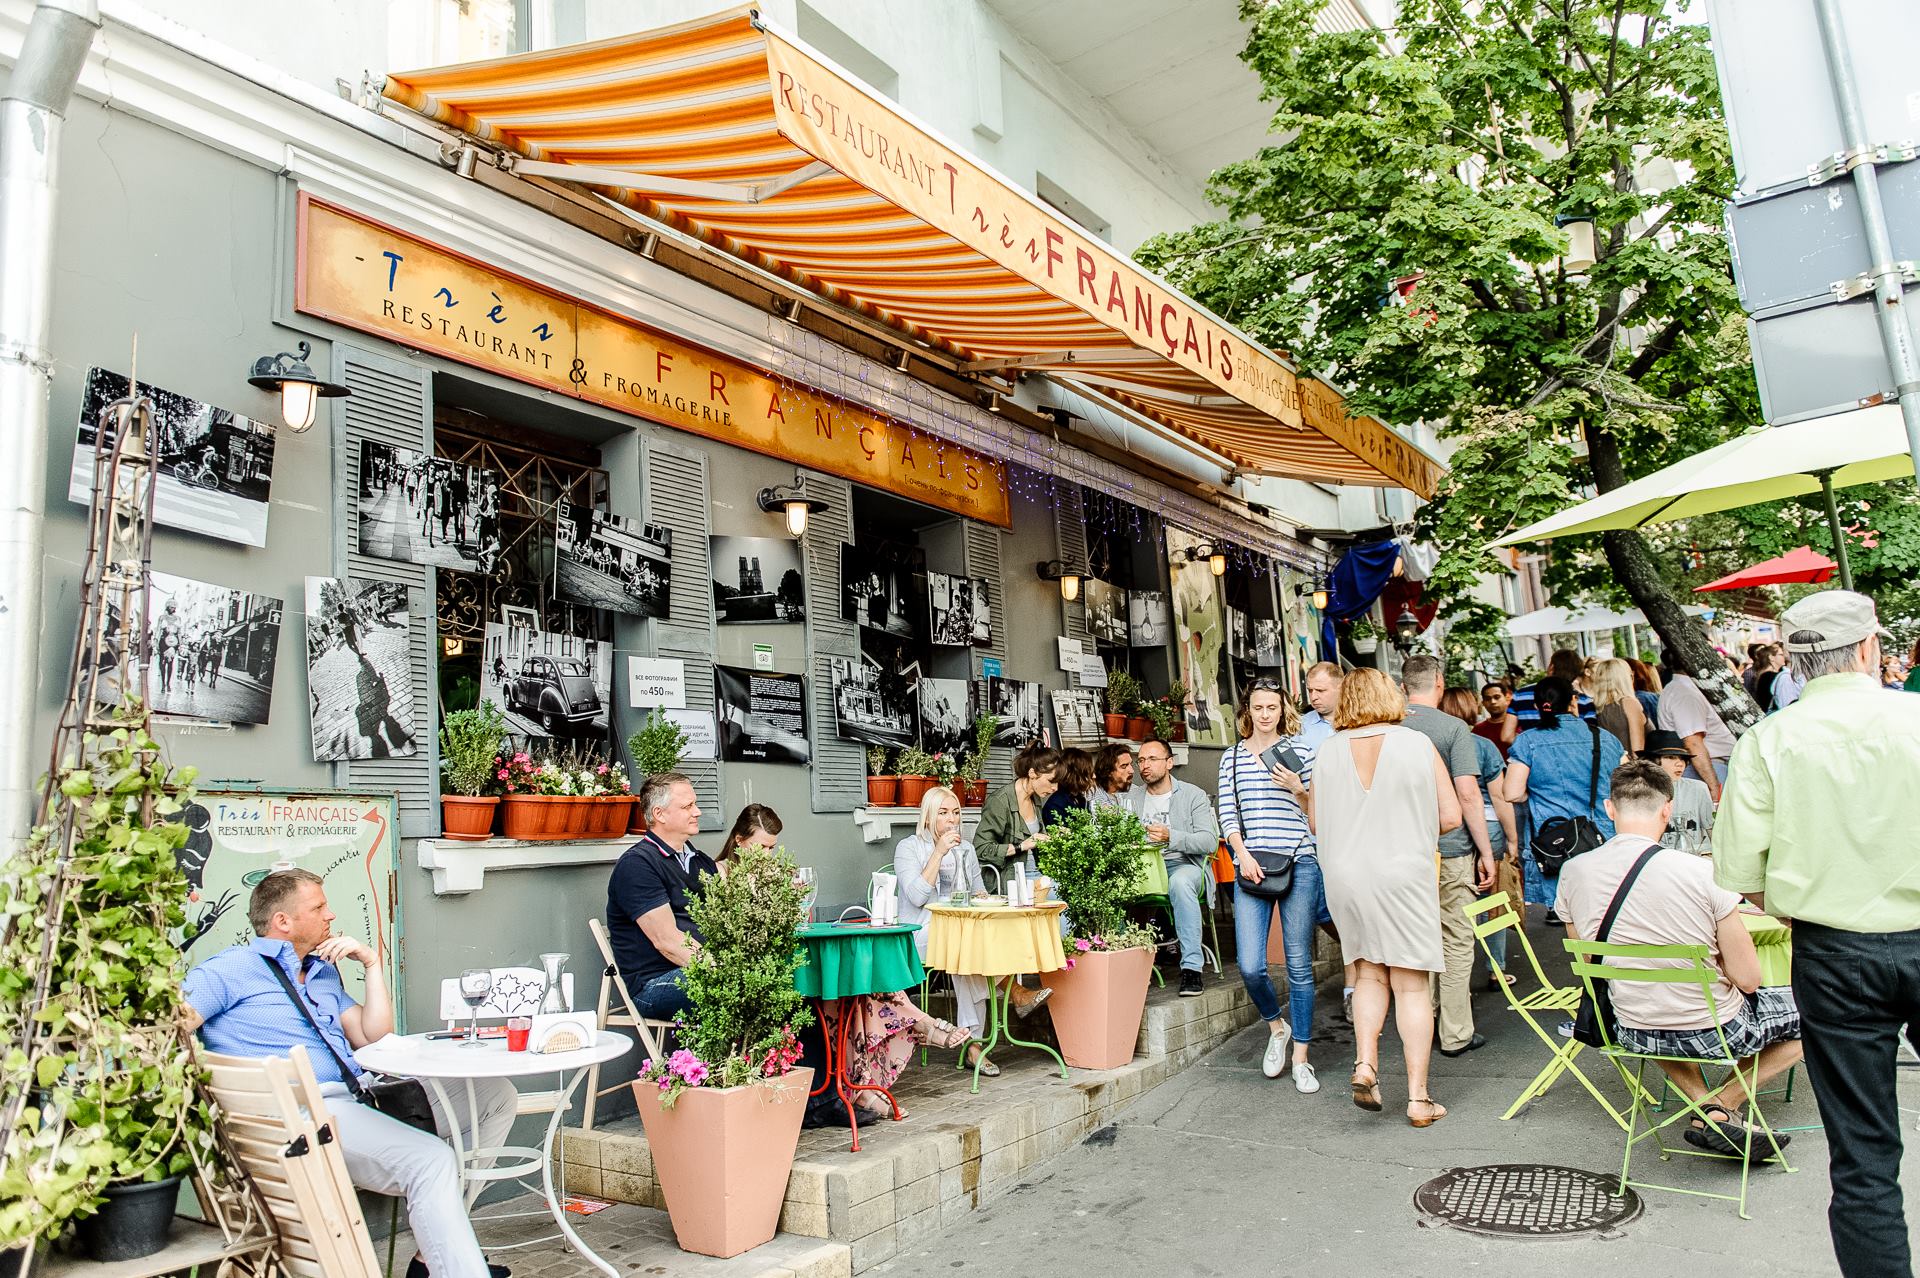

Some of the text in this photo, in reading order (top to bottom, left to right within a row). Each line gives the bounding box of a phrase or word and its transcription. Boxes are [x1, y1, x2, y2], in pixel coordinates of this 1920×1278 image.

[777, 70, 935, 196] RESTAURANT
[944, 162, 1039, 264] Très
[1045, 227, 1235, 382] FRANÇAIS
[382, 299, 733, 427] RESTAURANT & FROMAGERIE
[383, 251, 980, 492] Très FRANÇAIS
[648, 686, 664, 695] 450
[218, 804, 359, 826] Très FRANÇAIS
[218, 823, 358, 838] RESTAURANT & FROMAGERIE
